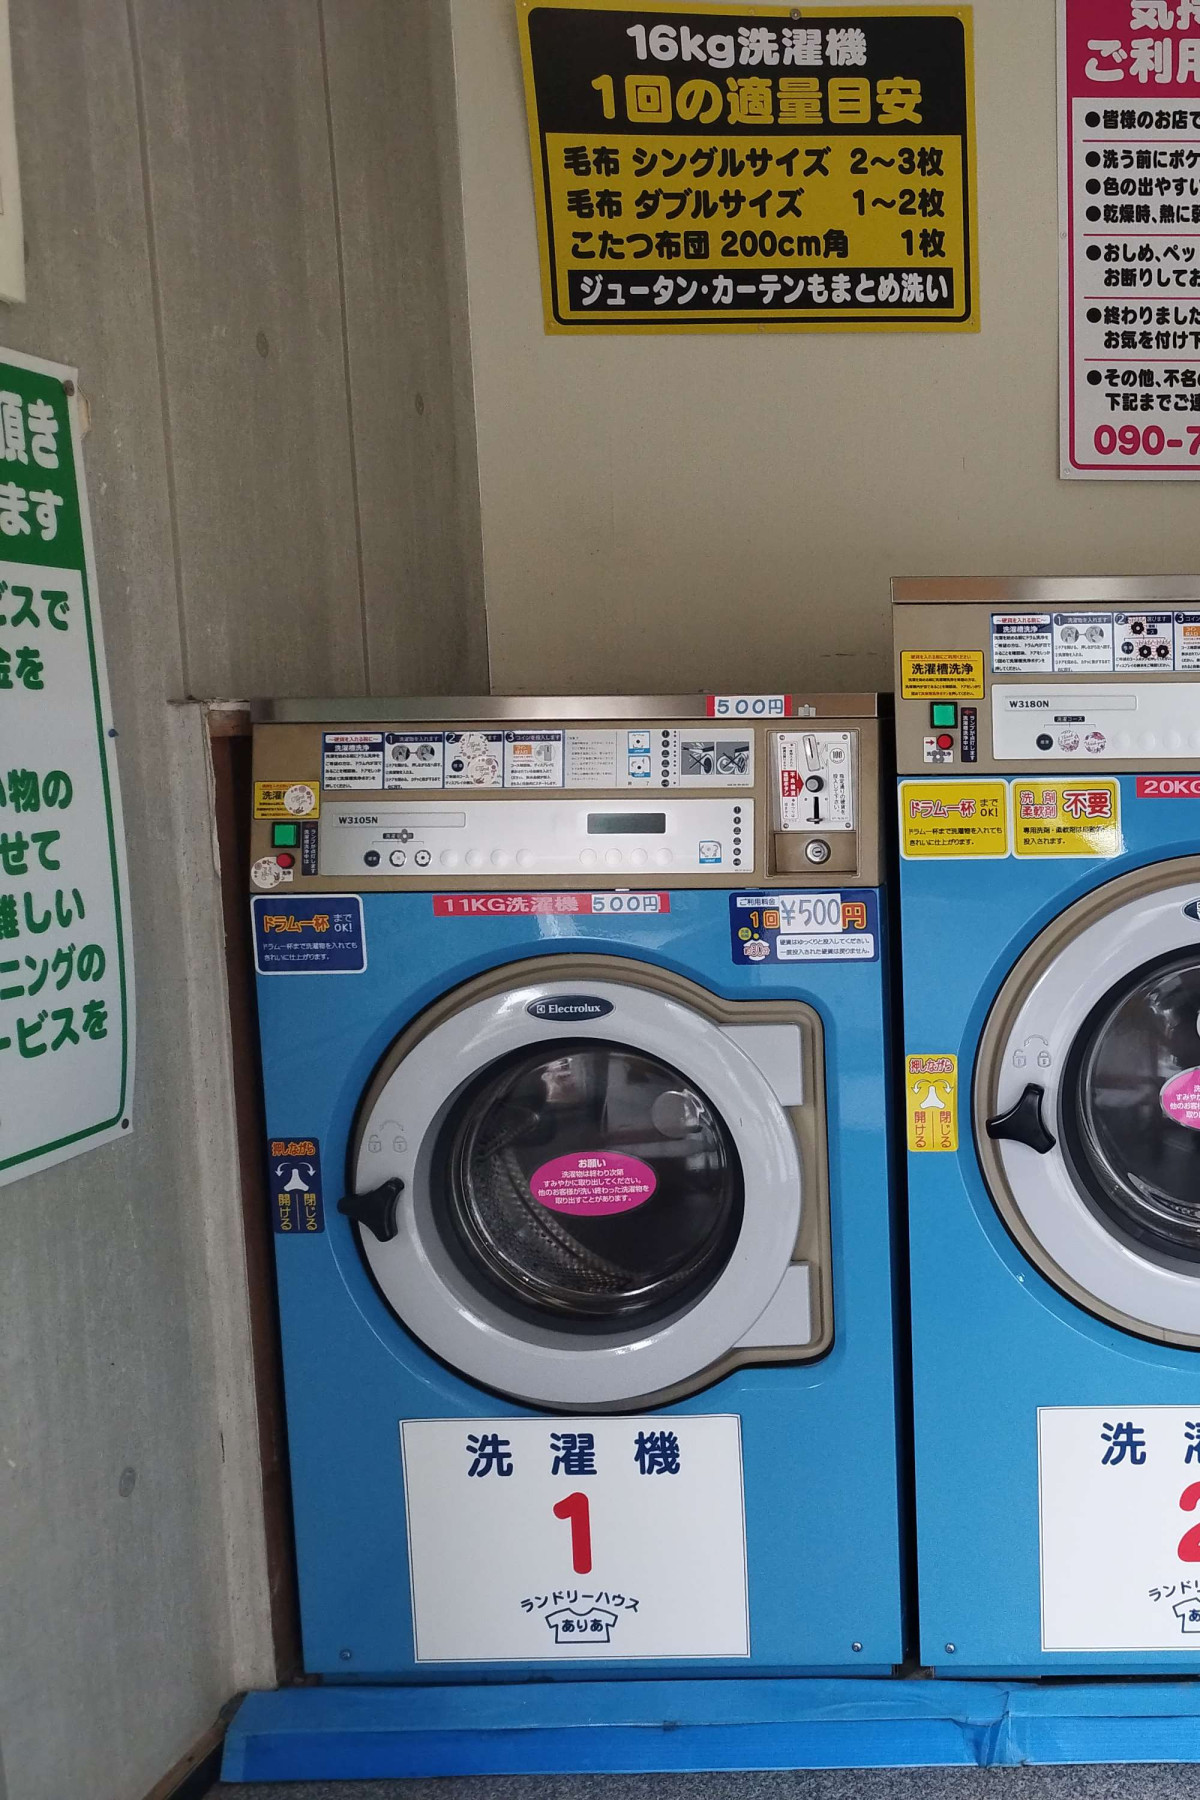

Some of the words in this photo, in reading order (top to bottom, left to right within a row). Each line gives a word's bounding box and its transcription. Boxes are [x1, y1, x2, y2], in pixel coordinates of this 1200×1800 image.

[627, 24, 868, 68] 16kg洗濯機
[591, 74, 923, 125] 1回の適量目安
[563, 146, 620, 177] 毛布
[632, 145, 832, 179] シングルサイズ
[566, 188, 623, 219] 毛布
[634, 187, 805, 220] ダブルサイズ
[570, 229, 711, 260] こたつ布団
[720, 229, 849, 259] 200cm角
[901, 229, 947, 258] 1枚
[911, 663, 974, 675] 洗濯槽洗浄
[717, 698, 784, 715] 500円
[1009, 700, 1050, 708] W3180N
[909, 799, 977, 819] ドラム一杯
[1020, 804, 1058, 819] 柔軟剤
[1062, 789, 1112, 819] 不要
[338, 816, 379, 824] W3105N
[443, 896, 579, 913] 11KG洗濯機
[593, 896, 659, 912] 500円
[263, 914, 331, 933] ドラム一杯
[749, 910, 780, 929] 1回
[548, 1003, 601, 1014] Electrolux
[909, 1057, 954, 1074] 押しながら
[914, 1110, 927, 1148] 開ける
[939, 1110, 952, 1148] 閉じる
[271, 1140, 316, 1157] 押しながら
[578, 1158, 607, 1169] お願い
[277, 1192, 292, 1231] 開ける
[303, 1192, 318, 1231] 閉じる
[465, 1430, 681, 1478] 洗濯機
[552, 1491, 593, 1575] 1
[520, 1589, 641, 1614] ランドリーハウス
[561, 1618, 605, 1633] ありあ
